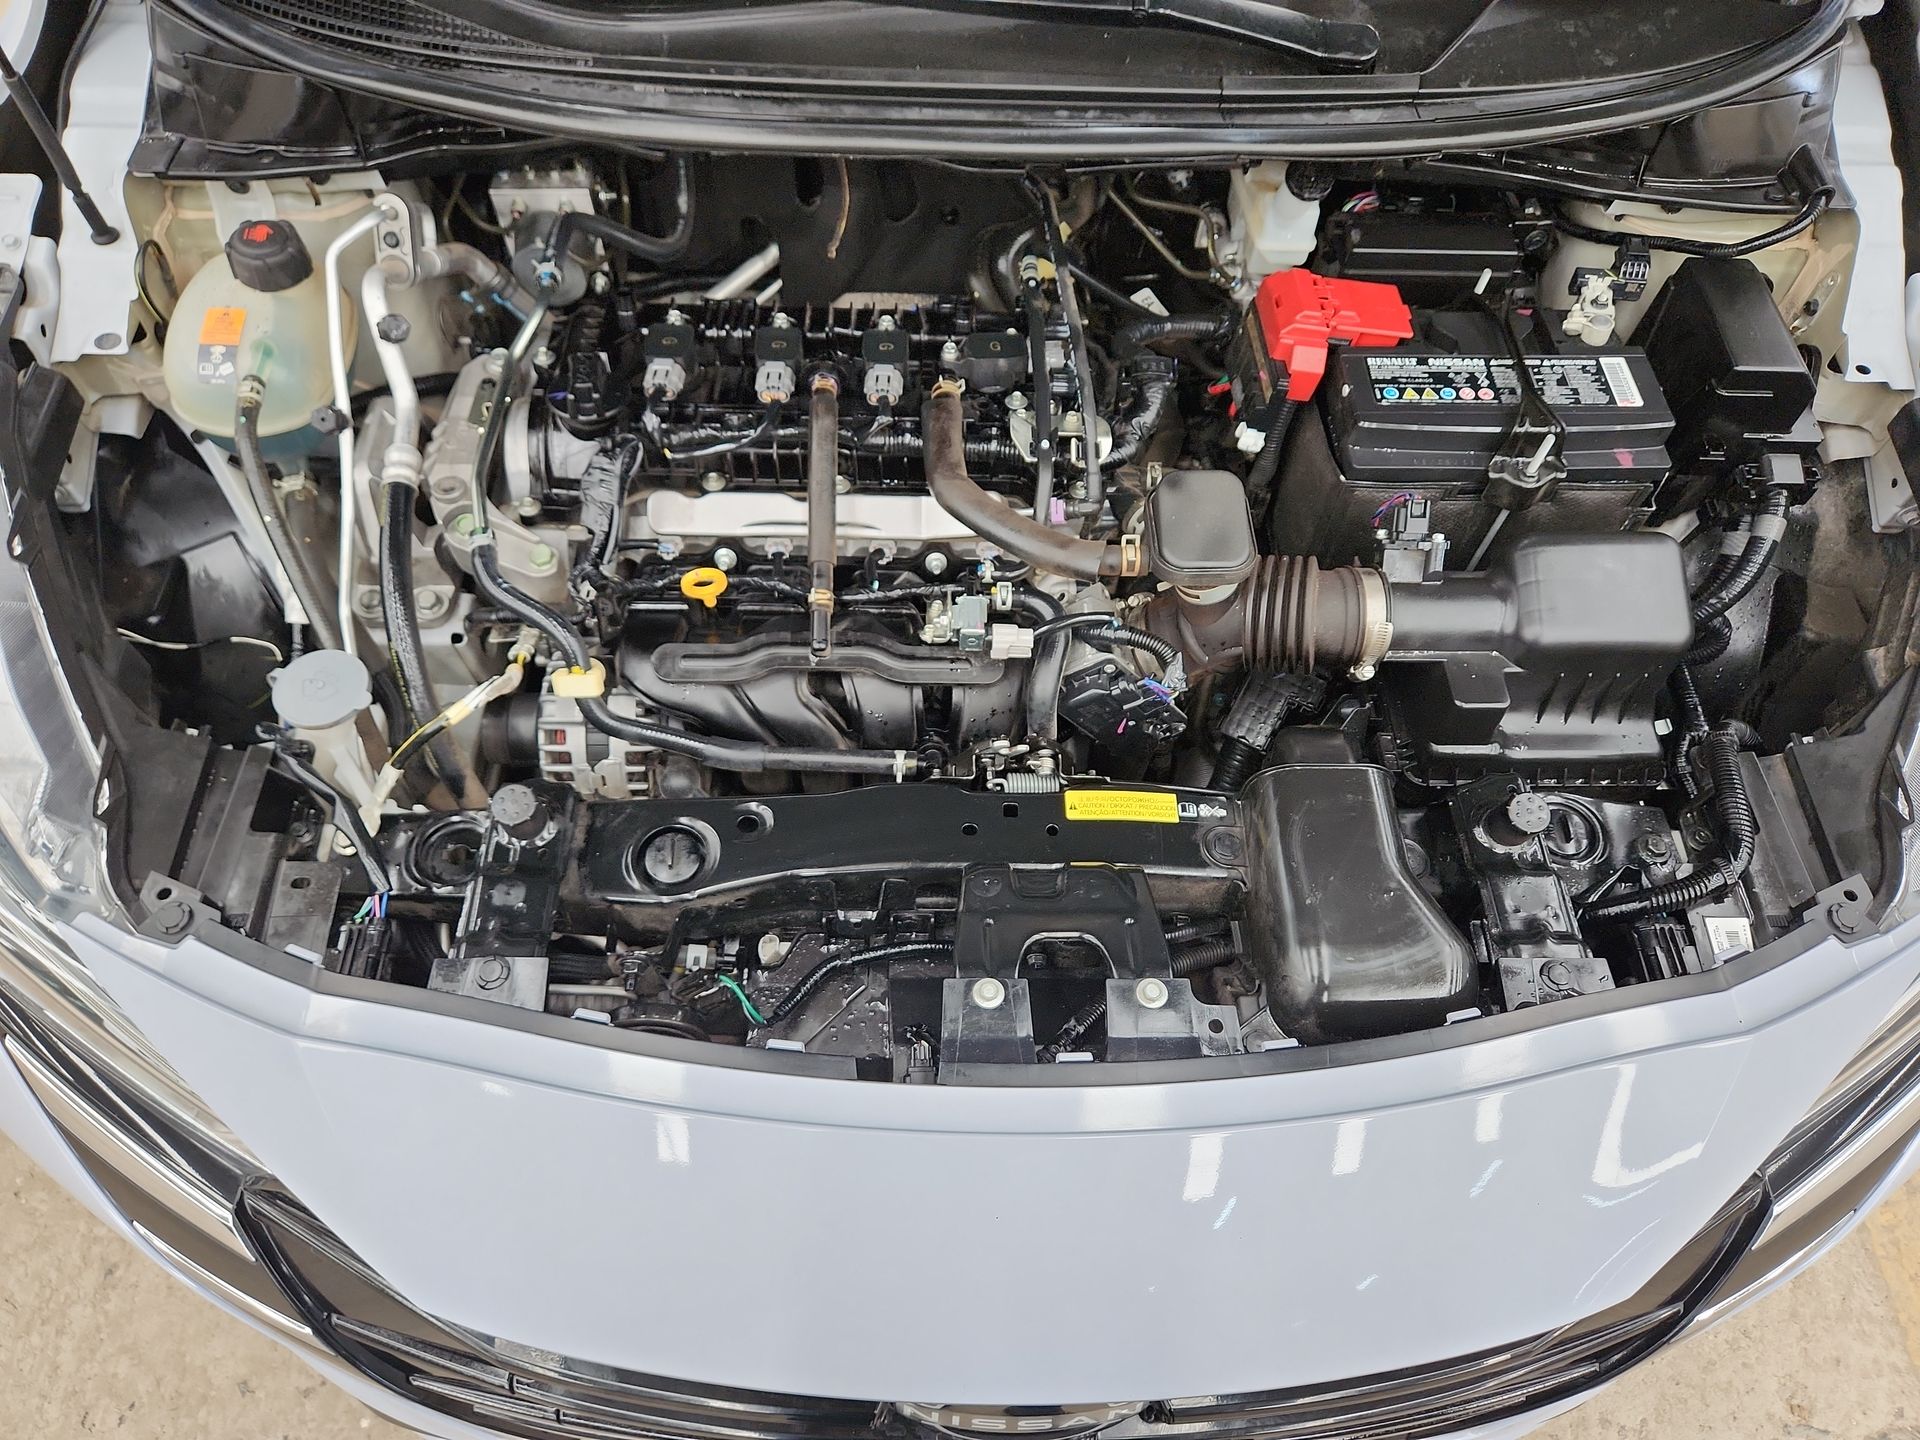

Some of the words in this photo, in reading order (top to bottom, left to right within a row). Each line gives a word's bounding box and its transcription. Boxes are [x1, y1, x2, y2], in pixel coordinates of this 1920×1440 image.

[990, 341, 1001, 351] G
[1367, 357, 1418, 366] RENAULT
[1428, 358, 1486, 367] NISSAN
[904, 1402, 1144, 1431] NISSAN
